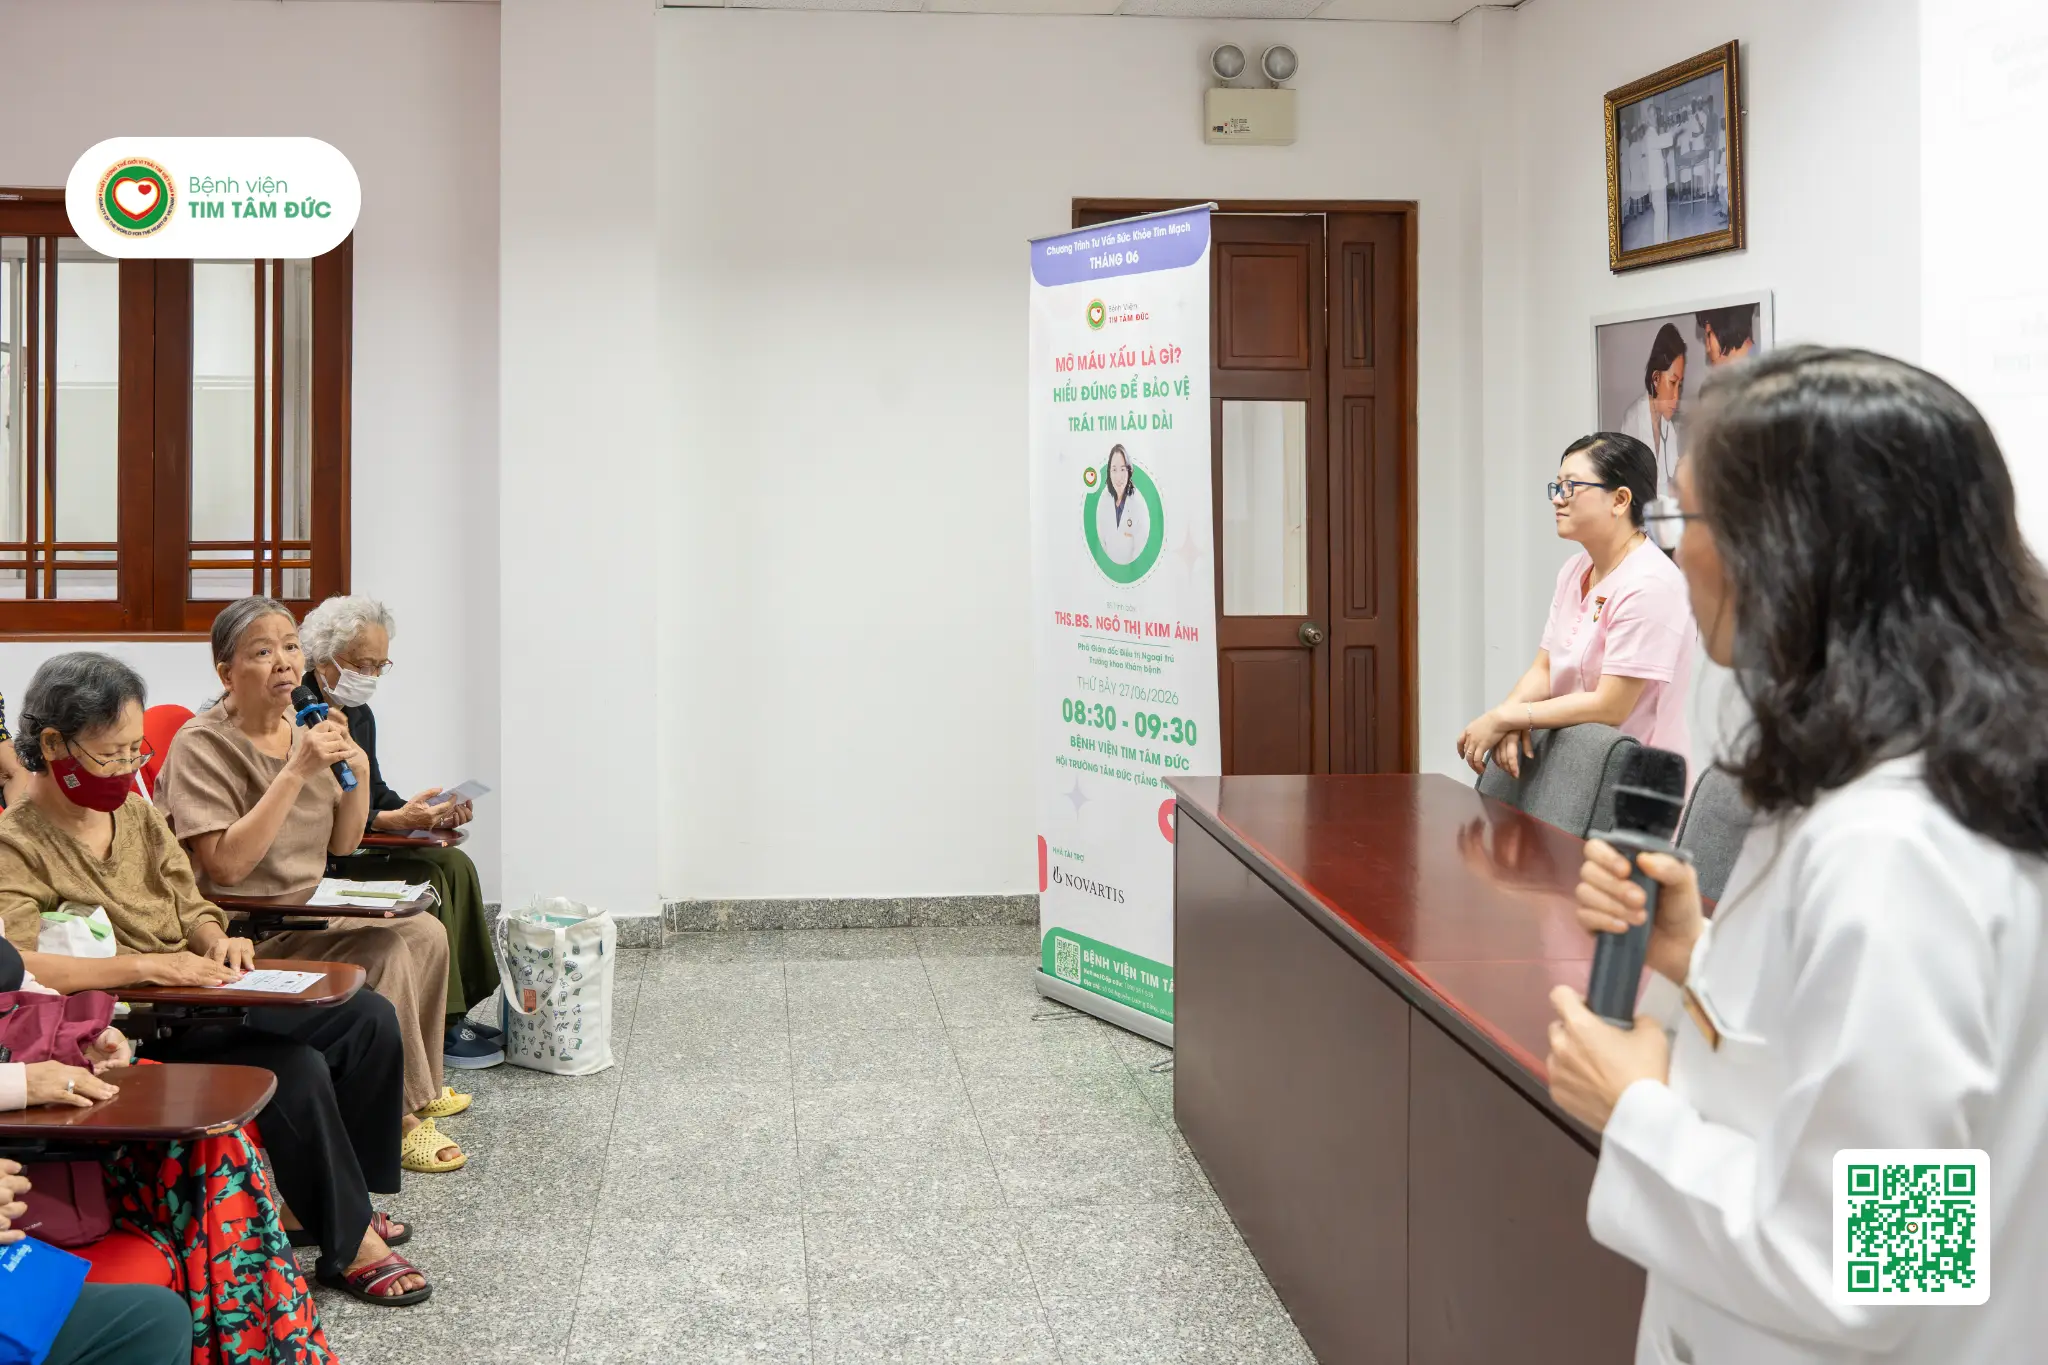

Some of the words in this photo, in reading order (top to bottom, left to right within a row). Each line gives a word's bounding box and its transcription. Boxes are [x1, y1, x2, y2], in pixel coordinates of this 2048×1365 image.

[1046, 245, 1072, 256] Chương
[1074, 240, 1090, 251] Trình
[1092, 238, 1100, 248] Tư
[1101, 234, 1116, 246] Vấn
[1117, 233, 1131, 244] Sức
[1132, 228, 1152, 240] Khỏe
[1153, 225, 1167, 238] Tim
[1168, 222, 1190, 236] Mạch
[1090, 252, 1122, 270] THÁNG
[1126, 251, 1140, 264] 06
[1109, 316, 1118, 324] TIM
[1078, 350, 1106, 370] MÁU
[1110, 344, 1136, 368] XẤU
[1141, 346, 1156, 366] LÀ
[1160, 344, 1182, 364] GÌ?
[1054, 378, 1077, 402] HIỂU
[1081, 381, 1116, 400] ĐÚNG
[1121, 374, 1138, 399] ĐỂ
[1143, 376, 1170, 398] BẢO
[1174, 375, 1190, 400] VỆ
[1068, 412, 1094, 432] TRÁI
[1098, 416, 1117, 431] TIM
[1121, 410, 1146, 430] LÂU
[1152, 409, 1172, 430] DÀI
[1055, 611, 1092, 628] THS.BS.
[1096, 614, 1120, 632] NGÔ
[1124, 620, 1141, 639] THỊ
[1146, 622, 1170, 638] KIM
[1174, 621, 1198, 642] ÁNH
[1110, 660, 1123, 668] khoa
[1144, 665, 1162, 675] bệnh
[1142, 652, 1162, 663] Ngoại
[1078, 676, 1097, 692] THỨ
[1119, 683, 1178, 705] 27/06/2026
[1062, 698, 1116, 731] 08:30
[1135, 712, 1196, 746] 09:30
[1070, 734, 1096, 751] BỆNH
[1098, 740, 1118, 758] VIỆN
[1120, 746, 1136, 760] TIM
[1139, 748, 1160, 766] TÂM
[1164, 754, 1190, 770] ĐỨC
[1100, 764, 1114, 777] TÂM
[1116, 768, 1132, 782] ĐỨC
[1065, 873, 1124, 904] NOVARTIS
[1084, 950, 1110, 970] BỆNH
[1112, 960, 1136, 981] VIỆN
[1140, 970, 1159, 988] TIM
